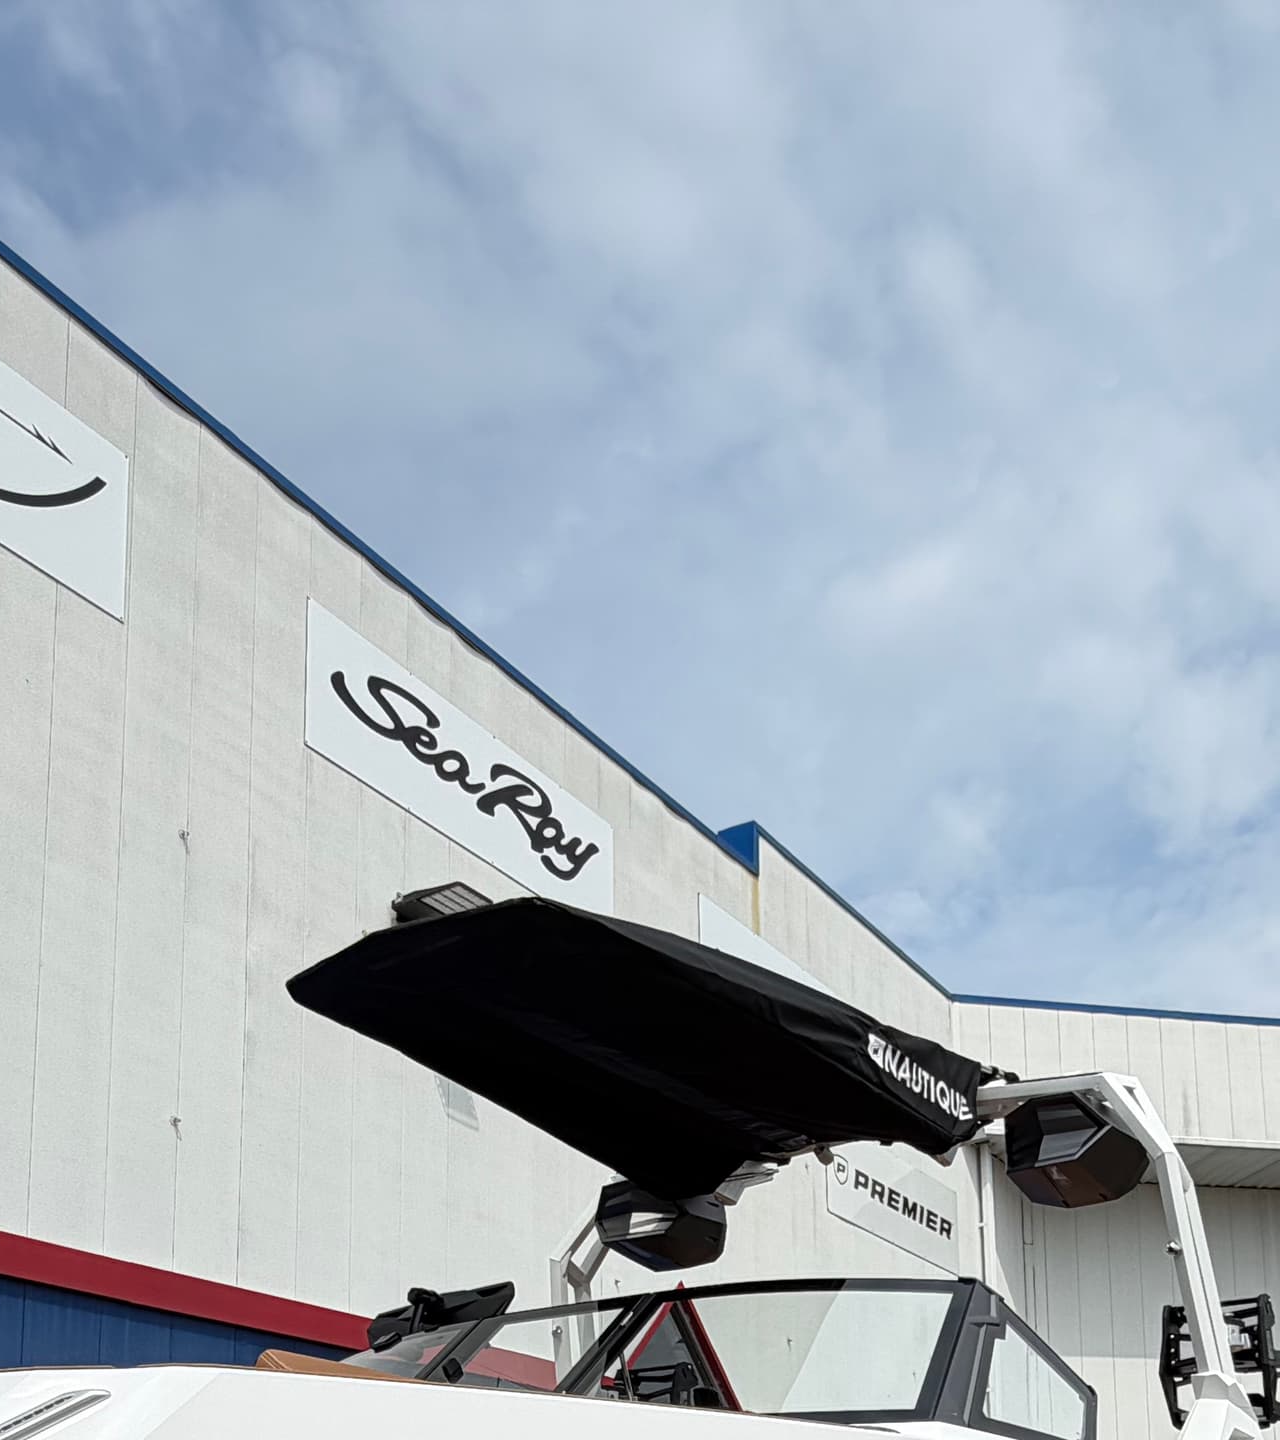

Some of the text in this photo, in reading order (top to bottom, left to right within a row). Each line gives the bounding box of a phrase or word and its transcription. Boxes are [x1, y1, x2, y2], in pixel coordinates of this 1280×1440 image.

[330, 671, 600, 881] Sea Ray
[883, 1045, 974, 1121] NAUTIQUE
[853, 1169, 954, 1240] PREMIER
